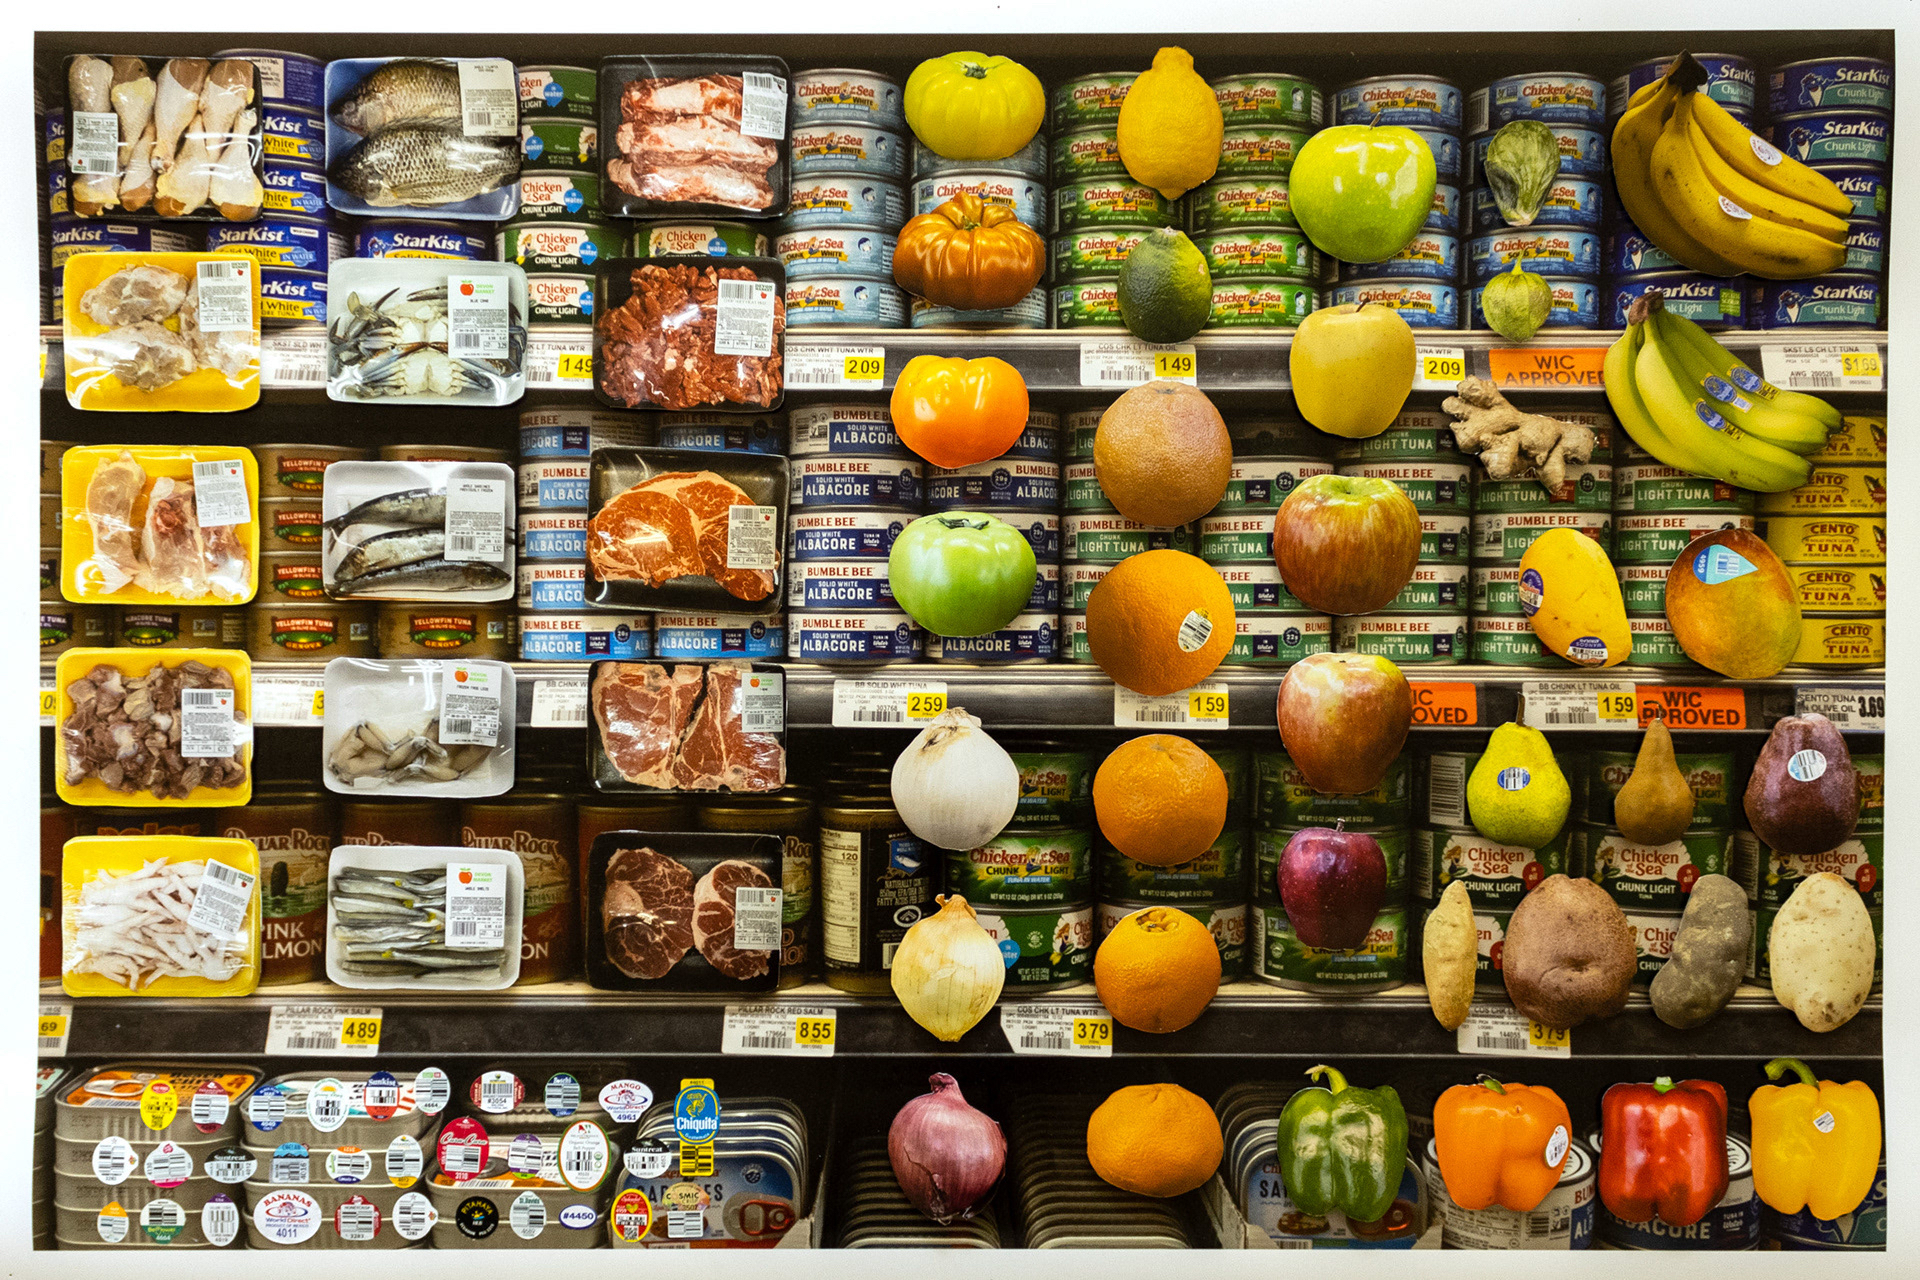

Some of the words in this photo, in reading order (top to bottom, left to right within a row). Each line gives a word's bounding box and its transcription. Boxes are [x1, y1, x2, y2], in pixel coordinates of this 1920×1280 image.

[1834, 69, 1889, 85] StarKist
[799, 84, 839, 97] Chicken
[857, 85, 875, 97] Sea
[1377, 100, 1398, 108] SOLID
[1416, 101, 1437, 109] WHITE
[1822, 122, 1884, 137] StarKist
[1824, 142, 1857, 152] Chunk
[1858, 142, 1876, 153] Light
[522, 182, 562, 195] Chicken
[1084, 188, 1124, 202] Chicken
[1138, 188, 1155, 200] Sea
[825, 199, 846, 208] WHITE
[219, 228, 283, 245] StarKist
[536, 233, 578, 246] Chicken
[666, 231, 706, 246] Chicken
[394, 236, 462, 254] StarKist
[677, 240, 696, 252] Sea
[1079, 237, 1118, 251] Chicken
[1212, 241, 1252, 255] Chicken
[1265, 242, 1283, 253] Sea
[1422, 251, 1441, 260] WHITE
[1548, 249, 1570, 258] WHITE
[534, 256, 555, 266] CHUNK
[556, 256, 578, 266] LIGHT
[536, 283, 578, 296] Chicken
[1812, 286, 1874, 301] StarKist
[1212, 292, 1250, 305] Chicken
[1263, 292, 1281, 303] Sea
[1813, 305, 1846, 315] Chunk
[1847, 305, 1866, 316] Light
[563, 357, 594, 373] 149
[848, 359, 880, 374] 209
[1160, 357, 1191, 372] 149
[1428, 360, 1461, 376] 209
[1533, 355, 1575, 370] WIC
[832, 431, 900, 446] ALBACORE
[1363, 439, 1399, 451] LIGHT
[1401, 438, 1433, 450] TUNA
[282, 459, 322, 469] YELLOWFIN
[804, 462, 847, 474] BUMBLE
[848, 462, 870, 473] BEE
[1363, 468, 1407, 479] BUMBLE
[1410, 468, 1433, 478] BEE
[1278, 477, 1292, 486] 22g
[805, 483, 870, 497] ALBACORE
[1637, 489, 1673, 501] LIGHT
[1676, 489, 1710, 500] TUNA
[1481, 491, 1512, 503] LIGHT
[1514, 490, 1546, 502] TUNA
[1793, 494, 1845, 505] TUNA
[278, 513, 315, 522] YELLOWFIN
[528, 518, 562, 529] BUMBLE
[564, 518, 588, 529] BEE
[797, 517, 833, 528] BUMBLE
[834, 516, 856, 527] BEE
[1507, 516, 1556, 527] BUMBLE
[1558, 516, 1579, 526] BEE
[1080, 520, 1122, 530] BUMBLE
[1123, 520, 1146, 530] BEE
[1811, 523, 1855, 535] CENTO
[797, 538, 856, 551] ALBACORE
[1080, 541, 1111, 552] LIGHT
[1113, 541, 1145, 552] TUNA
[1620, 540, 1650, 552] LIGHT
[1652, 539, 1685, 551] TUNA
[1805, 542, 1855, 553] TUNA
[277, 566, 316, 576] YELLOWFIN
[1230, 571, 1251, 581] BEE
[1806, 572, 1851, 583] CENTO
[807, 587, 873, 600] ALBACORE
[1405, 591, 1436, 603] TUNA
[414, 617, 452, 627] YELLOWFIN
[453, 618, 472, 627] TUNA
[524, 620, 557, 630] BUMBLE
[558, 620, 582, 630] BEE
[660, 616, 695, 627] BUMBLE
[696, 616, 718, 626] BEE
[802, 617, 842, 629] BUMBLE
[843, 617, 866, 628] BEE
[1476, 621, 1515, 631] BUMBLE
[1831, 625, 1870, 637] CENTO
[285, 640, 322, 650] GENOVA
[424, 639, 460, 648] GENOVA
[525, 641, 582, 653] ALBACORE
[661, 637, 718, 650] ALBACORE
[802, 639, 866, 652] ALBACORE
[945, 639, 1011, 652] ALBACORE
[1361, 643, 1397, 655] LIGHT
[1399, 643, 1430, 655] TUNA
[911, 696, 943, 712] 259
[1194, 696, 1225, 712] 159
[1602, 696, 1634, 713] 159
[1663, 691, 1702, 708] WIC
[1811, 704, 1838, 713] OLIVE
[1840, 704, 1856, 713] OIL
[1858, 696, 1885, 718] 3.69
[1046, 771, 1067, 786] Sea
[841, 852, 858, 861] 120
[970, 848, 1026, 866] Chicken
[1048, 850, 1070, 863] Sea
[1468, 848, 1524, 865] Chicken
[1620, 848, 1679, 866] Chicken
[986, 866, 1019, 876] CHUNK
[1044, 865, 1069, 876] LIGHT
[1482, 862, 1509, 877] Sea
[1636, 862, 1663, 877] Sea
[1464, 881, 1495, 891] CHUNK
[1496, 882, 1522, 892] LIGHT
[1616, 881, 1646, 892] CHUNK
[1648, 883, 1675, 895] LIGHT
[1373, 929, 1394, 943] Sea
[286, 1006, 312, 1014] PILLAR
[313, 1007, 333, 1015] ROCK
[353, 1008, 371, 1016] SALM
[738, 1005, 764, 1013] PILLAR
[765, 1006, 785, 1014] ROCK
[788, 1006, 802, 1014] RED
[803, 1007, 824, 1015] SALM
[1017, 1006, 1033, 1014] COS
[1034, 1007, 1049, 1015] CHK
[1051, 1007, 1060, 1015] LT
[345, 1022, 377, 1039] 489
[799, 1021, 831, 1039] 855
[1077, 1023, 1109, 1040] 379
[368, 1078, 397, 1087] Sunkist
[610, 1083, 642, 1092] MANGO
[617, 1113, 637, 1121] 4961
[676, 1116, 718, 1134] Chiquita
[213, 1153, 246, 1162] Suntreat
[264, 1193, 312, 1208] BANANAS
[461, 1201, 494, 1215] PITAHAYA
[563, 1212, 594, 1220] #4450
[276, 1228, 298, 1238] 4011
